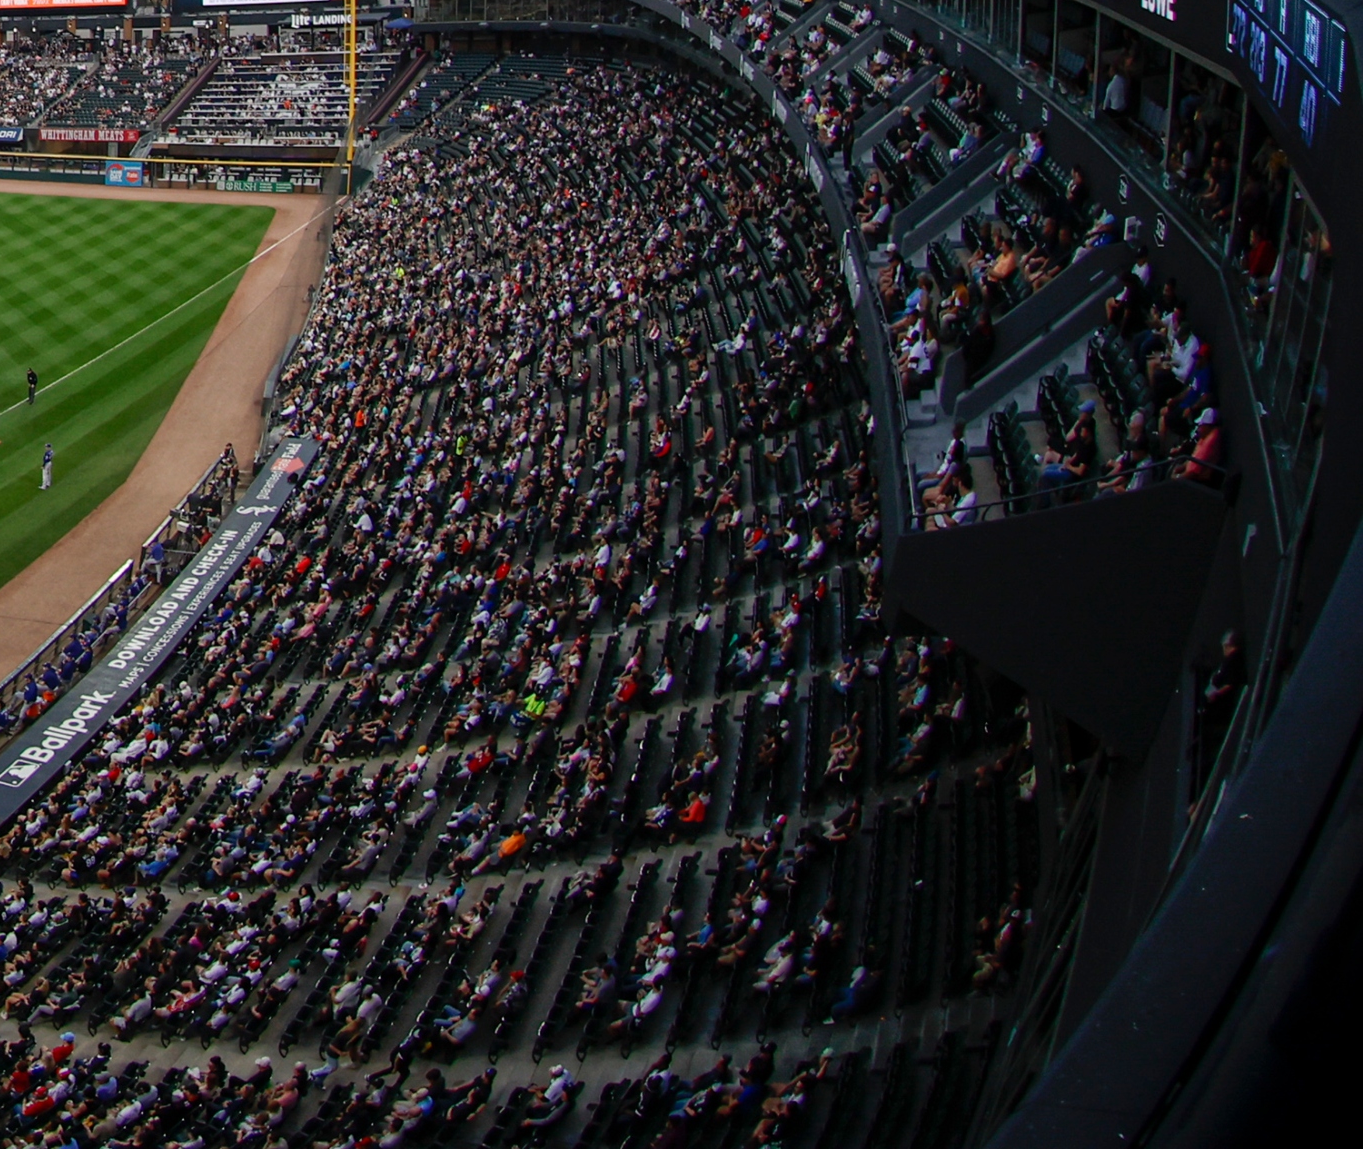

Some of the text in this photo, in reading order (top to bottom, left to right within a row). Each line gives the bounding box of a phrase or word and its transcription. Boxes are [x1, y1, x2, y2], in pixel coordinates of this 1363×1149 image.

[290, 14, 312, 28] Lite
[39, 129, 125, 141] WHITTINGHAM MEATS
[233, 181, 257, 192] RUSH
[281, 443, 303, 459] Field
[107, 529, 239, 670] DOWNLOAD AND CHECK-IN
[118, 520, 263, 690] MAPS CONCESSIONS EXPERIENCES SEAT UPGRADES
[20, 690, 114, 764] Ballpark
